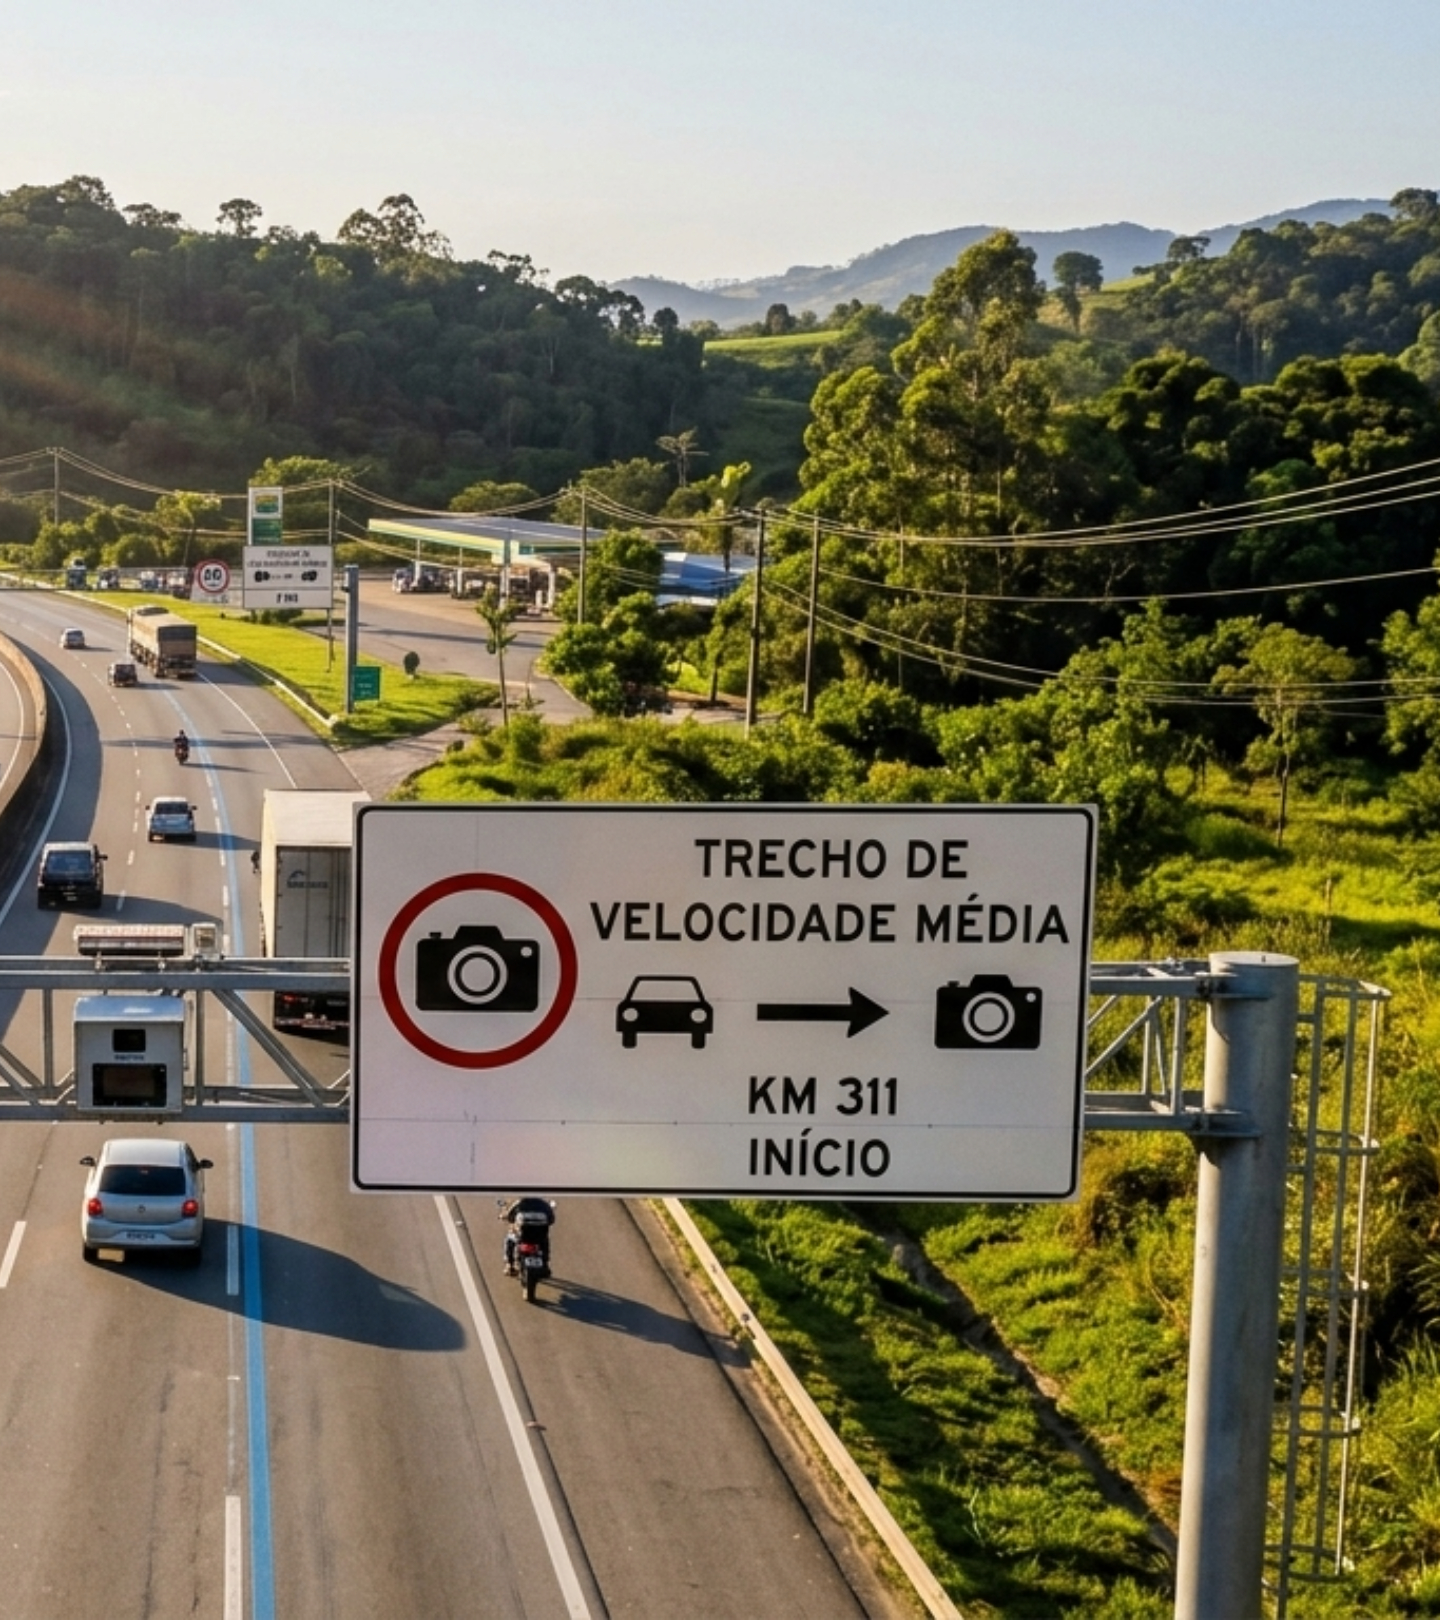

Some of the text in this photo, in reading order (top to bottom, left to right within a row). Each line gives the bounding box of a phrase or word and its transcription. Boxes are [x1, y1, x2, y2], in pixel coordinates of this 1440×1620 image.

[694, 838, 969, 880] TRECHO DE
[589, 892, 1070, 945] VELOCIDADE MÉDIA
[748, 1075, 899, 1117] KM 311
[749, 1127, 891, 1178] INÍCIO
